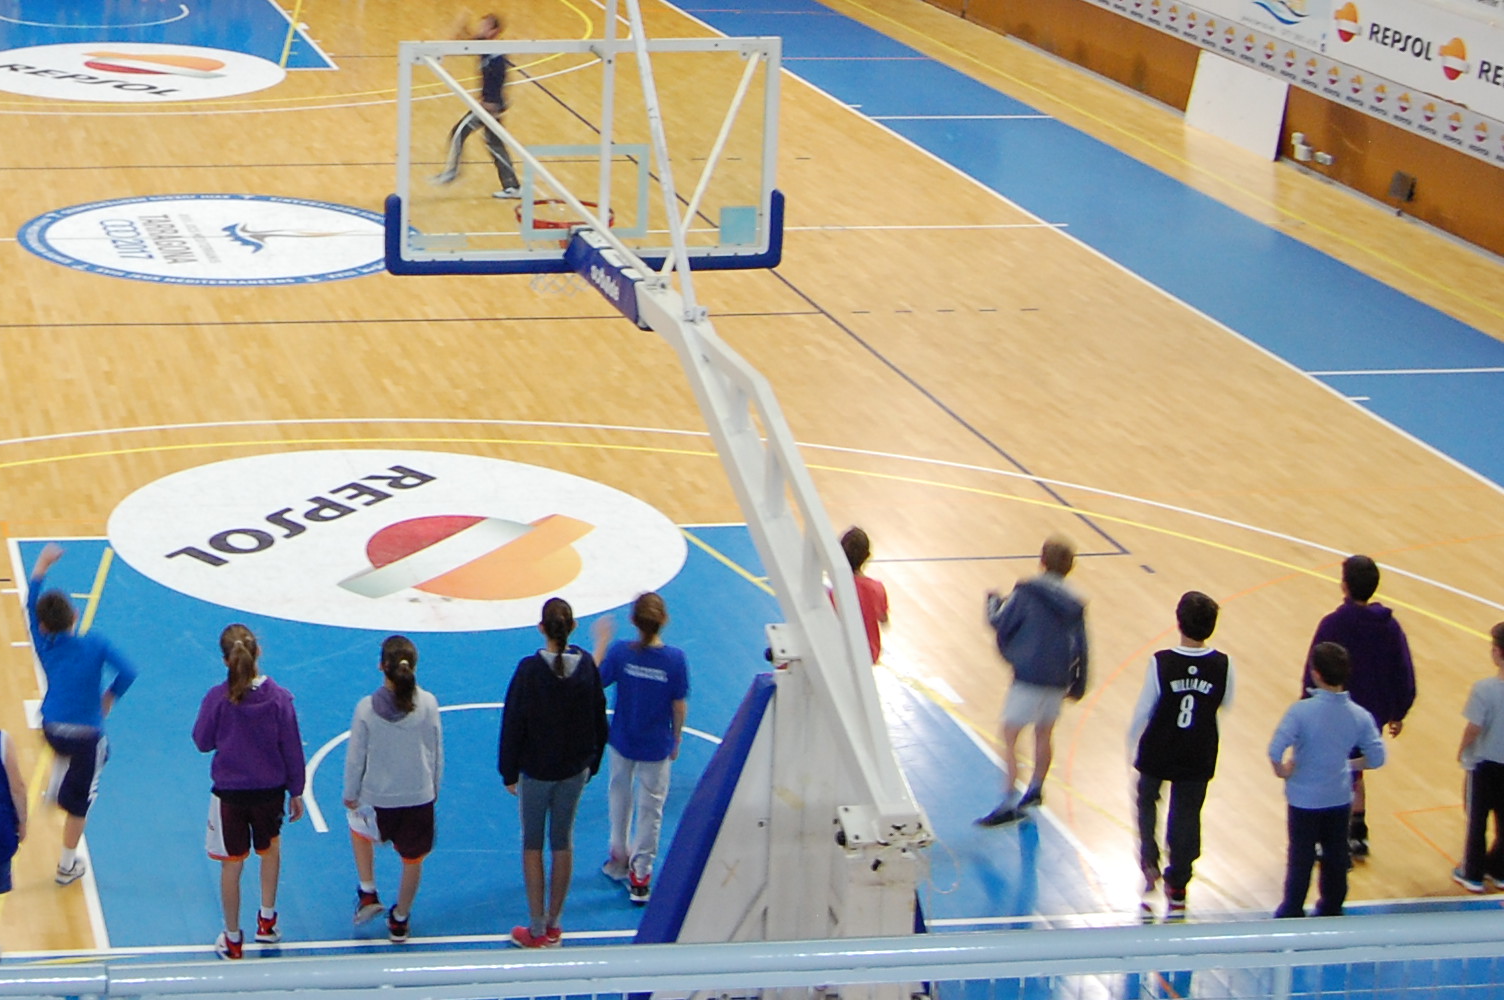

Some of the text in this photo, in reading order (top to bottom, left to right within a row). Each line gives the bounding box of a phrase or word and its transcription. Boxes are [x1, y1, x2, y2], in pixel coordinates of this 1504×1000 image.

[1368, 22, 1432, 61] REPSOL
[1478, 60, 1504, 88] RE
[112, 239, 155, 260] 2017
[138, 213, 198, 264] TARRAGONA
[164, 464, 438, 568] REPSOL
[1169, 678, 1213, 695] WILLIAMS
[1177, 693, 1194, 729] 8
